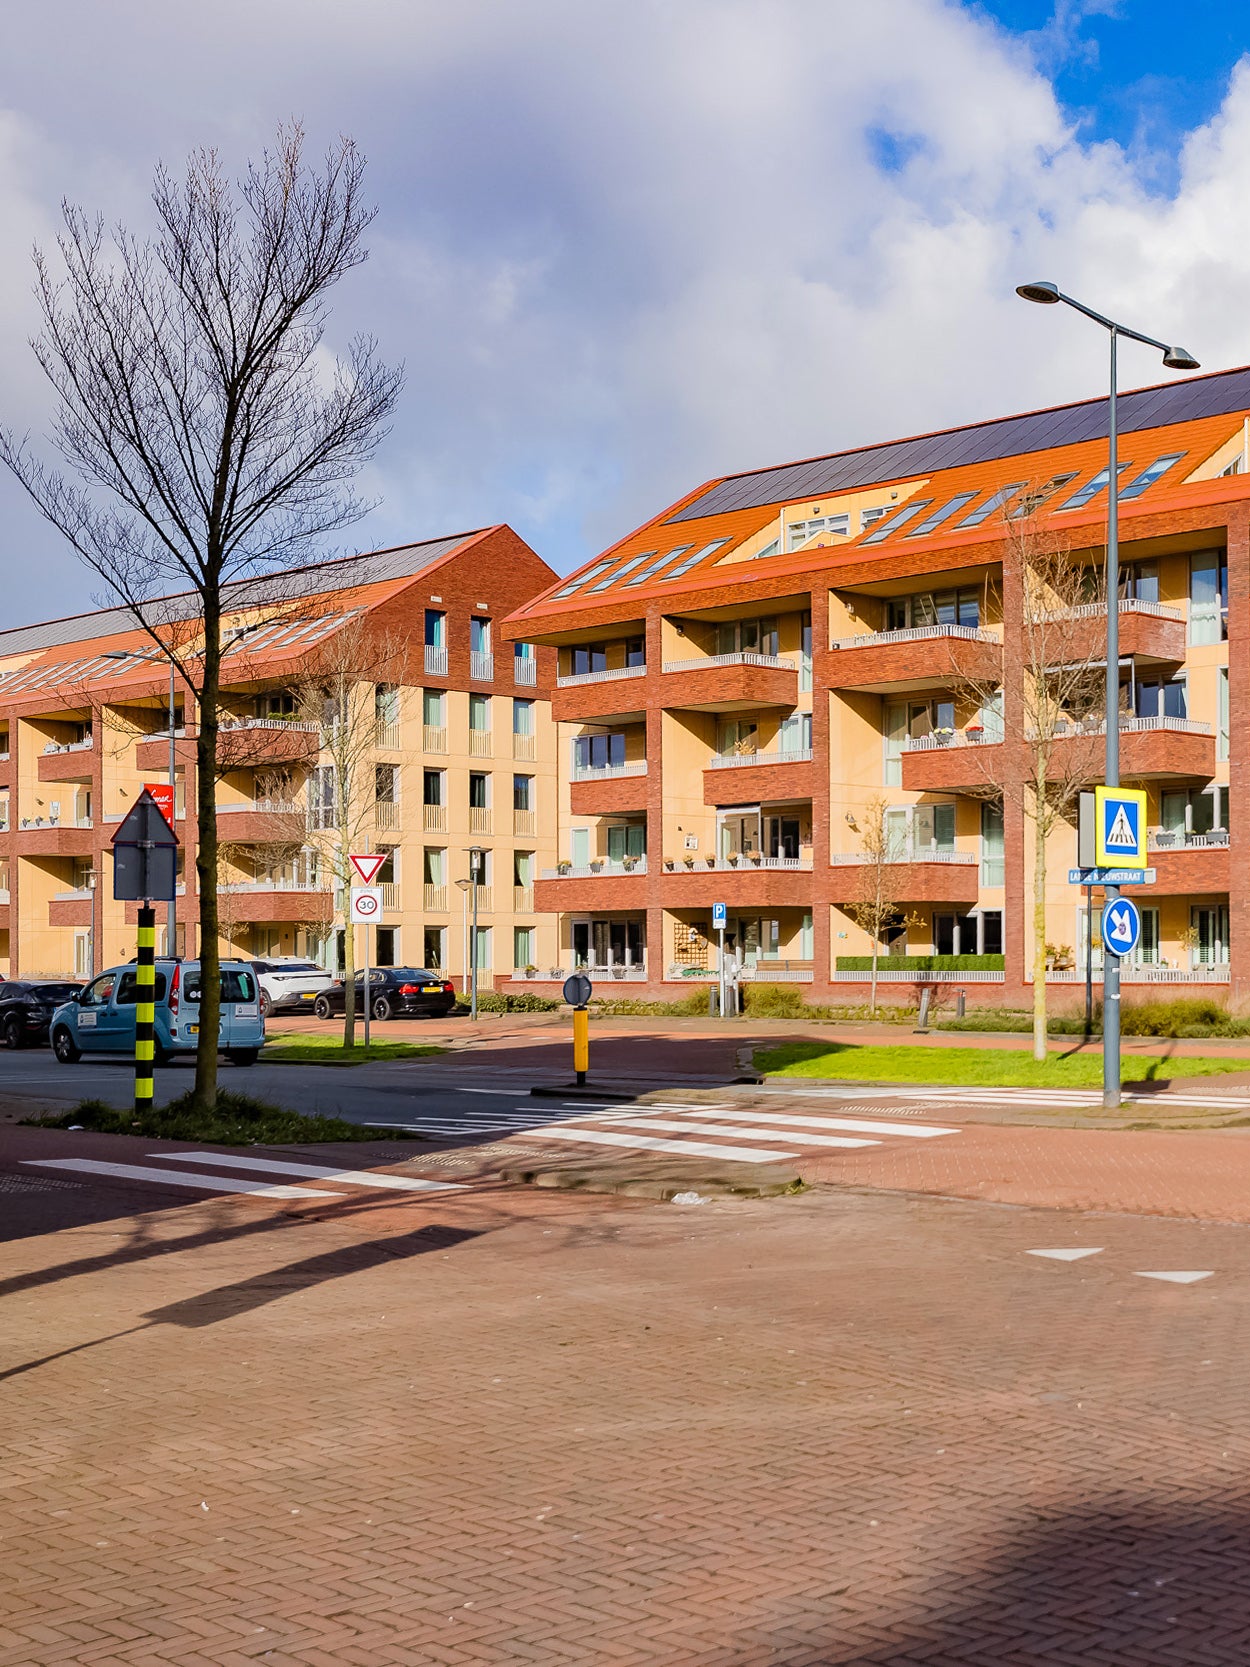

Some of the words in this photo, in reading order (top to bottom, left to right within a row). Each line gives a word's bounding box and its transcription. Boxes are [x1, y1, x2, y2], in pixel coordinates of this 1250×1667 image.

[1093, 871, 1142, 881] NIEUWSTRAAT
[359, 900, 375, 910] 30
[715, 905, 724, 919] P
